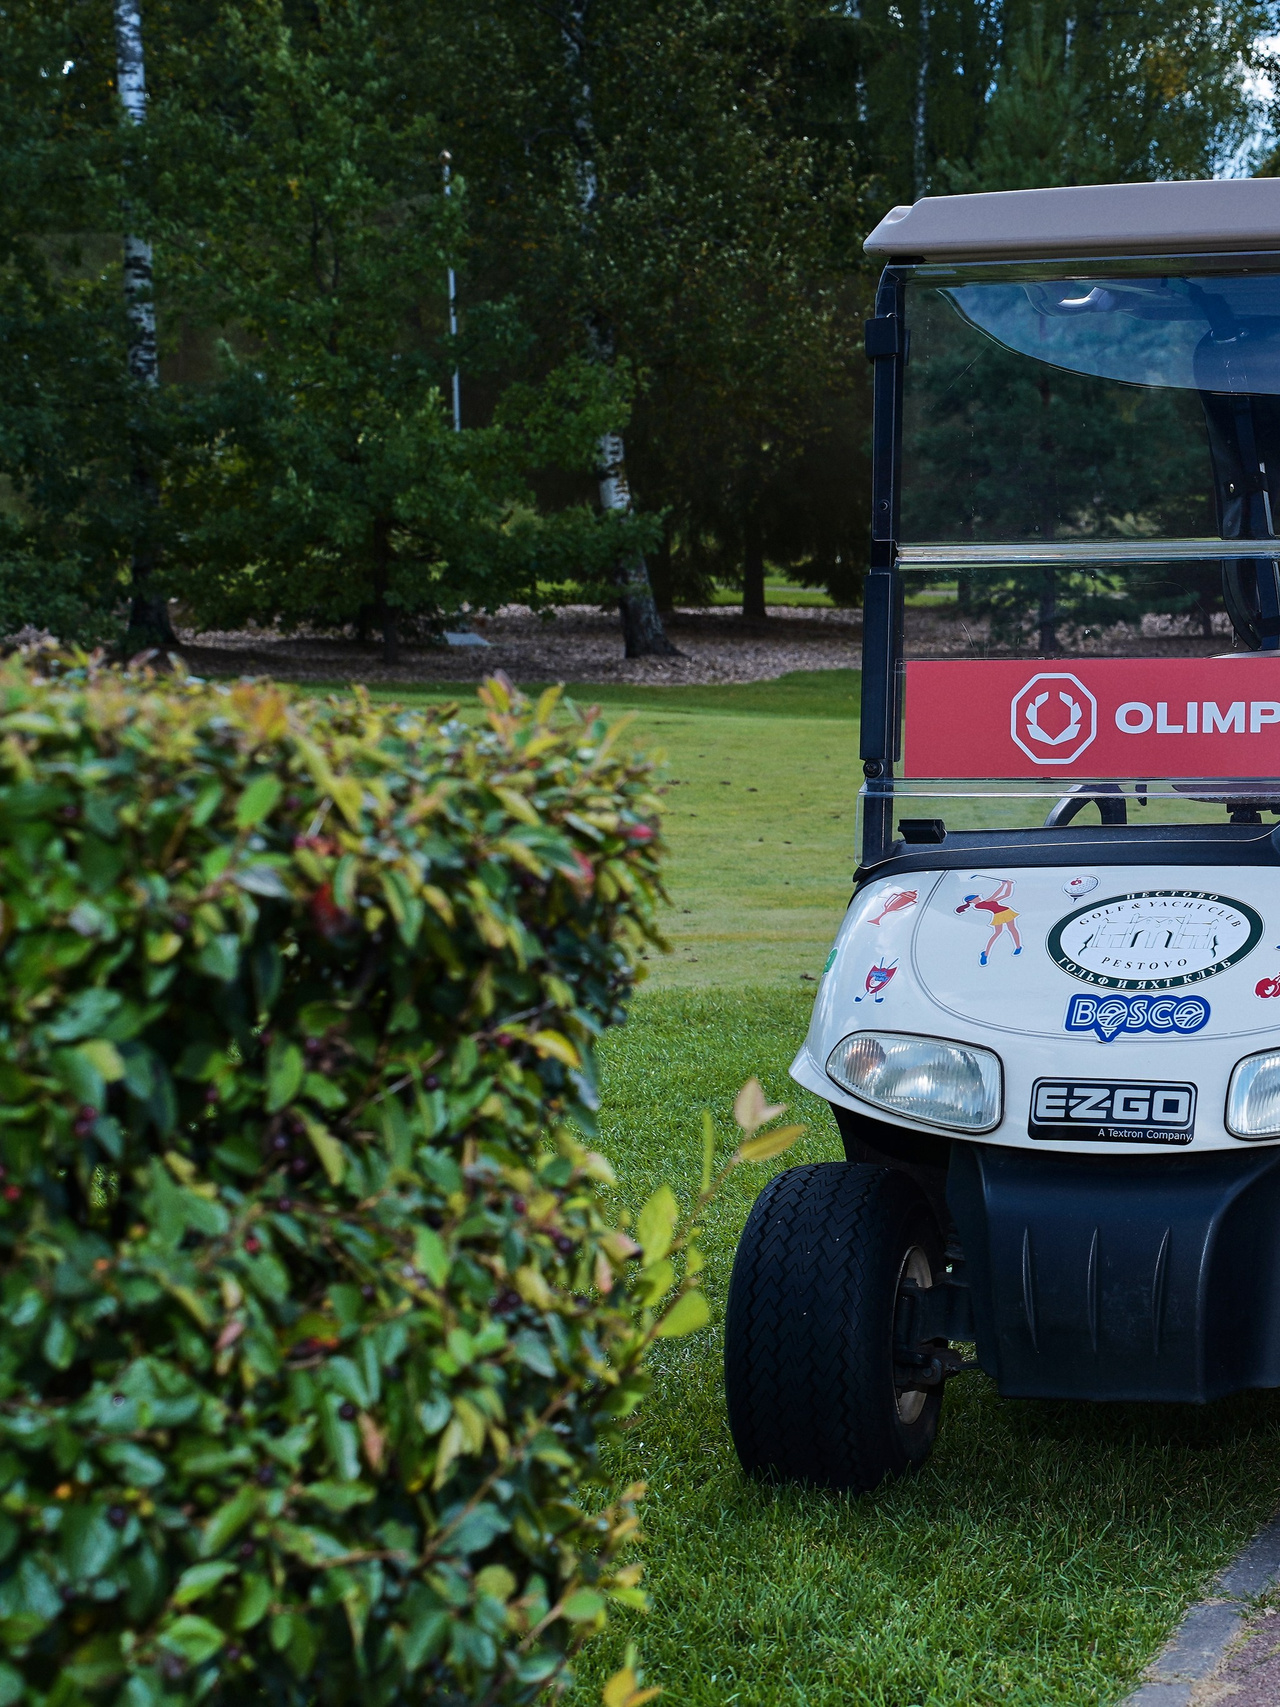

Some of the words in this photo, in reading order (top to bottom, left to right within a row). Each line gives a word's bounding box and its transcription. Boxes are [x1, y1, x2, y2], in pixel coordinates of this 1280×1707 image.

[1126, 890, 1220, 901] ПЕСТОВО
[1079, 904, 1124, 925] GOLF
[1131, 902, 1142, 910] &
[1149, 900, 1206, 911] YACHT
[1208, 906, 1243, 928] CLUB
[1057, 957, 1110, 987] ГОЛЬФ
[1116, 979, 1129, 989] И
[1135, 978, 1174, 990] ЯХТ
[1182, 958, 1233, 985] КЛУБ
[1101, 956, 1188, 971] PESTOVO
[1070, 997, 1206, 1032] BOSCO
[1035, 1086, 1191, 1122] EZGO
[1098, 1128, 1105, 1137] A
[1108, 1128, 1144, 1139] Textron
